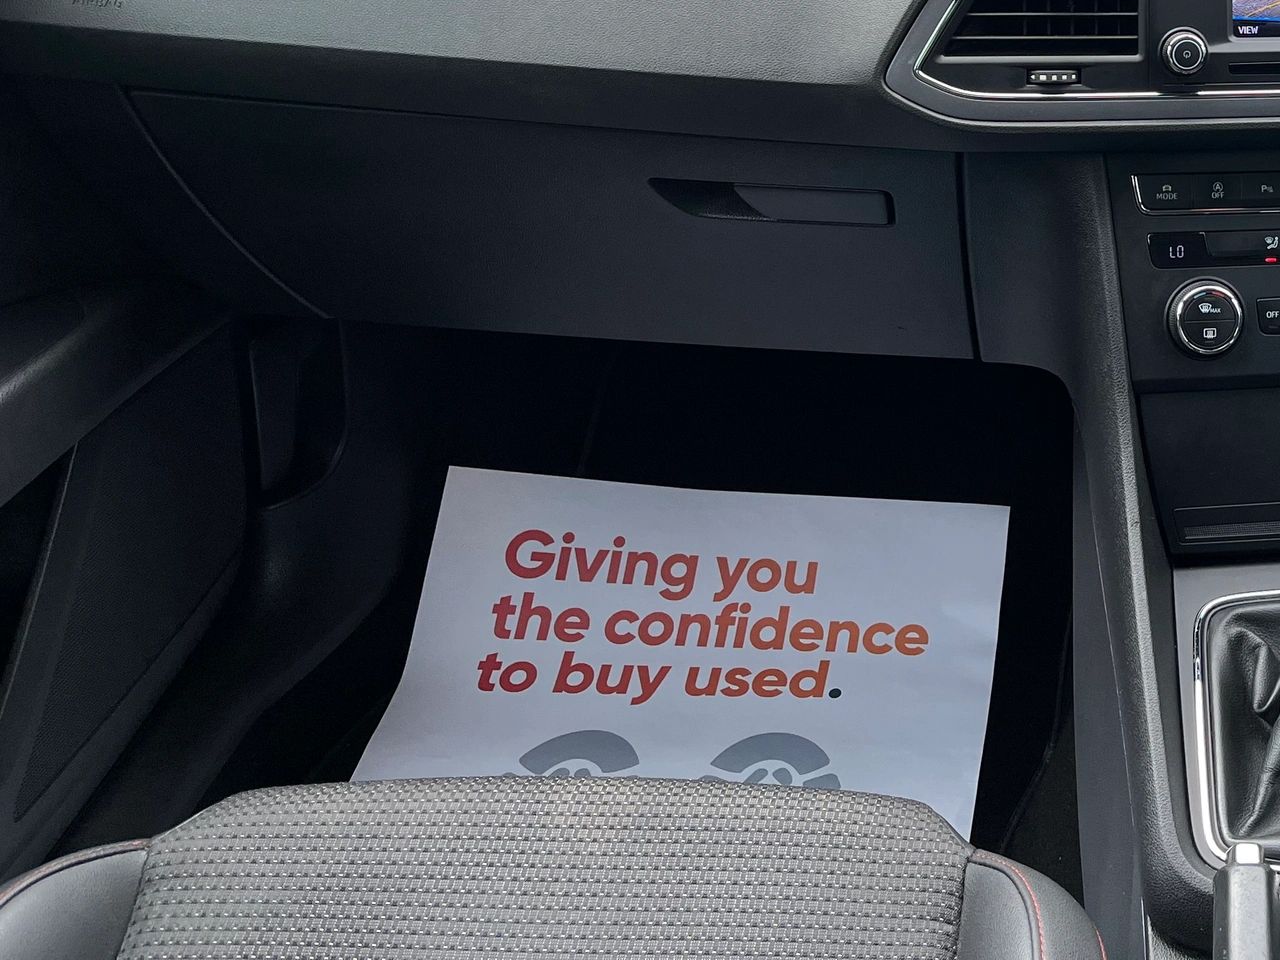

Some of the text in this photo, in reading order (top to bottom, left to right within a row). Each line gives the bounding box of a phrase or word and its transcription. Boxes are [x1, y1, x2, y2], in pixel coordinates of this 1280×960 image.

[1238, 25, 1259, 34] VIEW
[1156, 192, 1178, 201] MODE
[1211, 191, 1225, 200] OFF
[1169, 244, 1185, 259] LO
[1266, 310, 1279, 319] OFF
[504, 529, 819, 603] Giving you
[491, 592, 930, 657] the confidence
[477, 651, 843, 706] to buy used.
